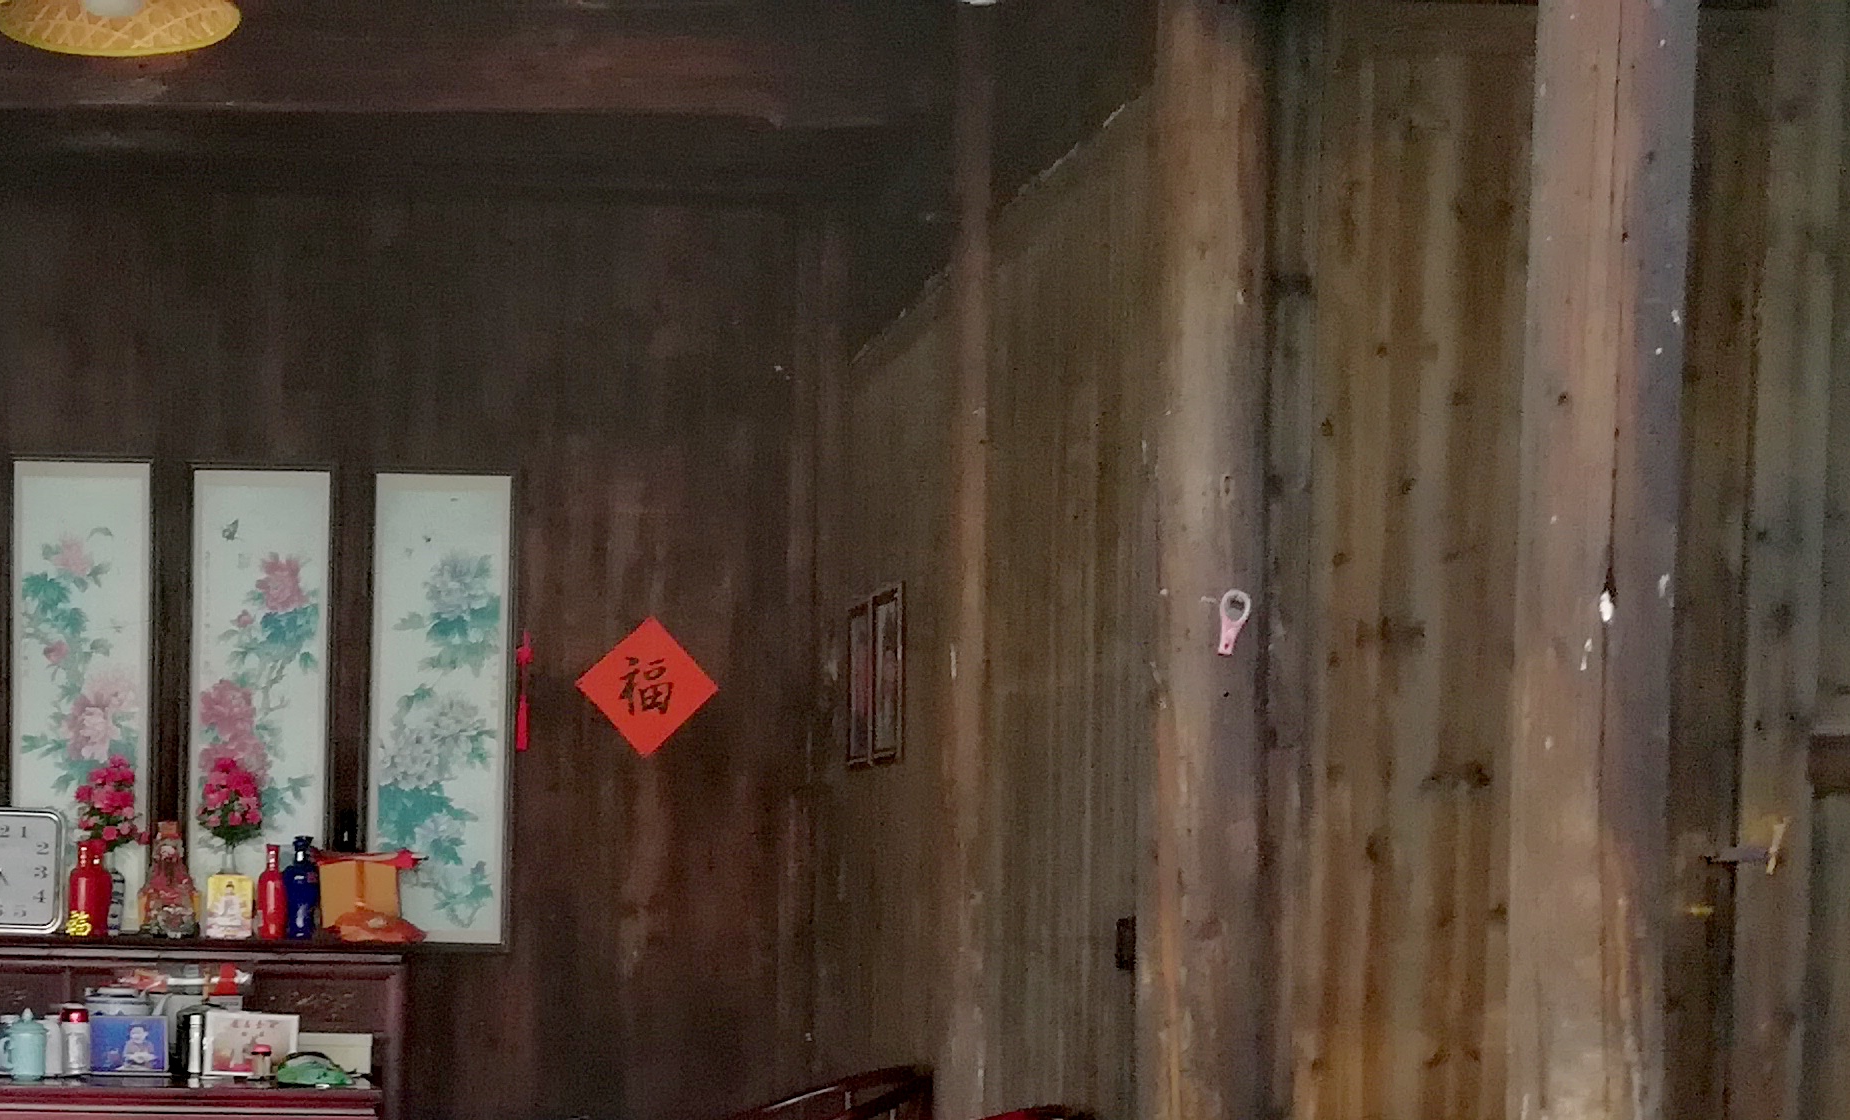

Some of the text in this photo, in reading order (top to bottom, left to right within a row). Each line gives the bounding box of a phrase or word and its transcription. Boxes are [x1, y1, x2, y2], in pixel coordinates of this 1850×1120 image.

[617, 656, 674, 716] 福
[20, 826, 27, 839] 1
[35, 841, 50, 855] 2
[33, 865, 48, 879] 3
[32, 889, 47, 904] 4
[13, 904, 27, 917] 5
[65, 910, 92, 936] 福
